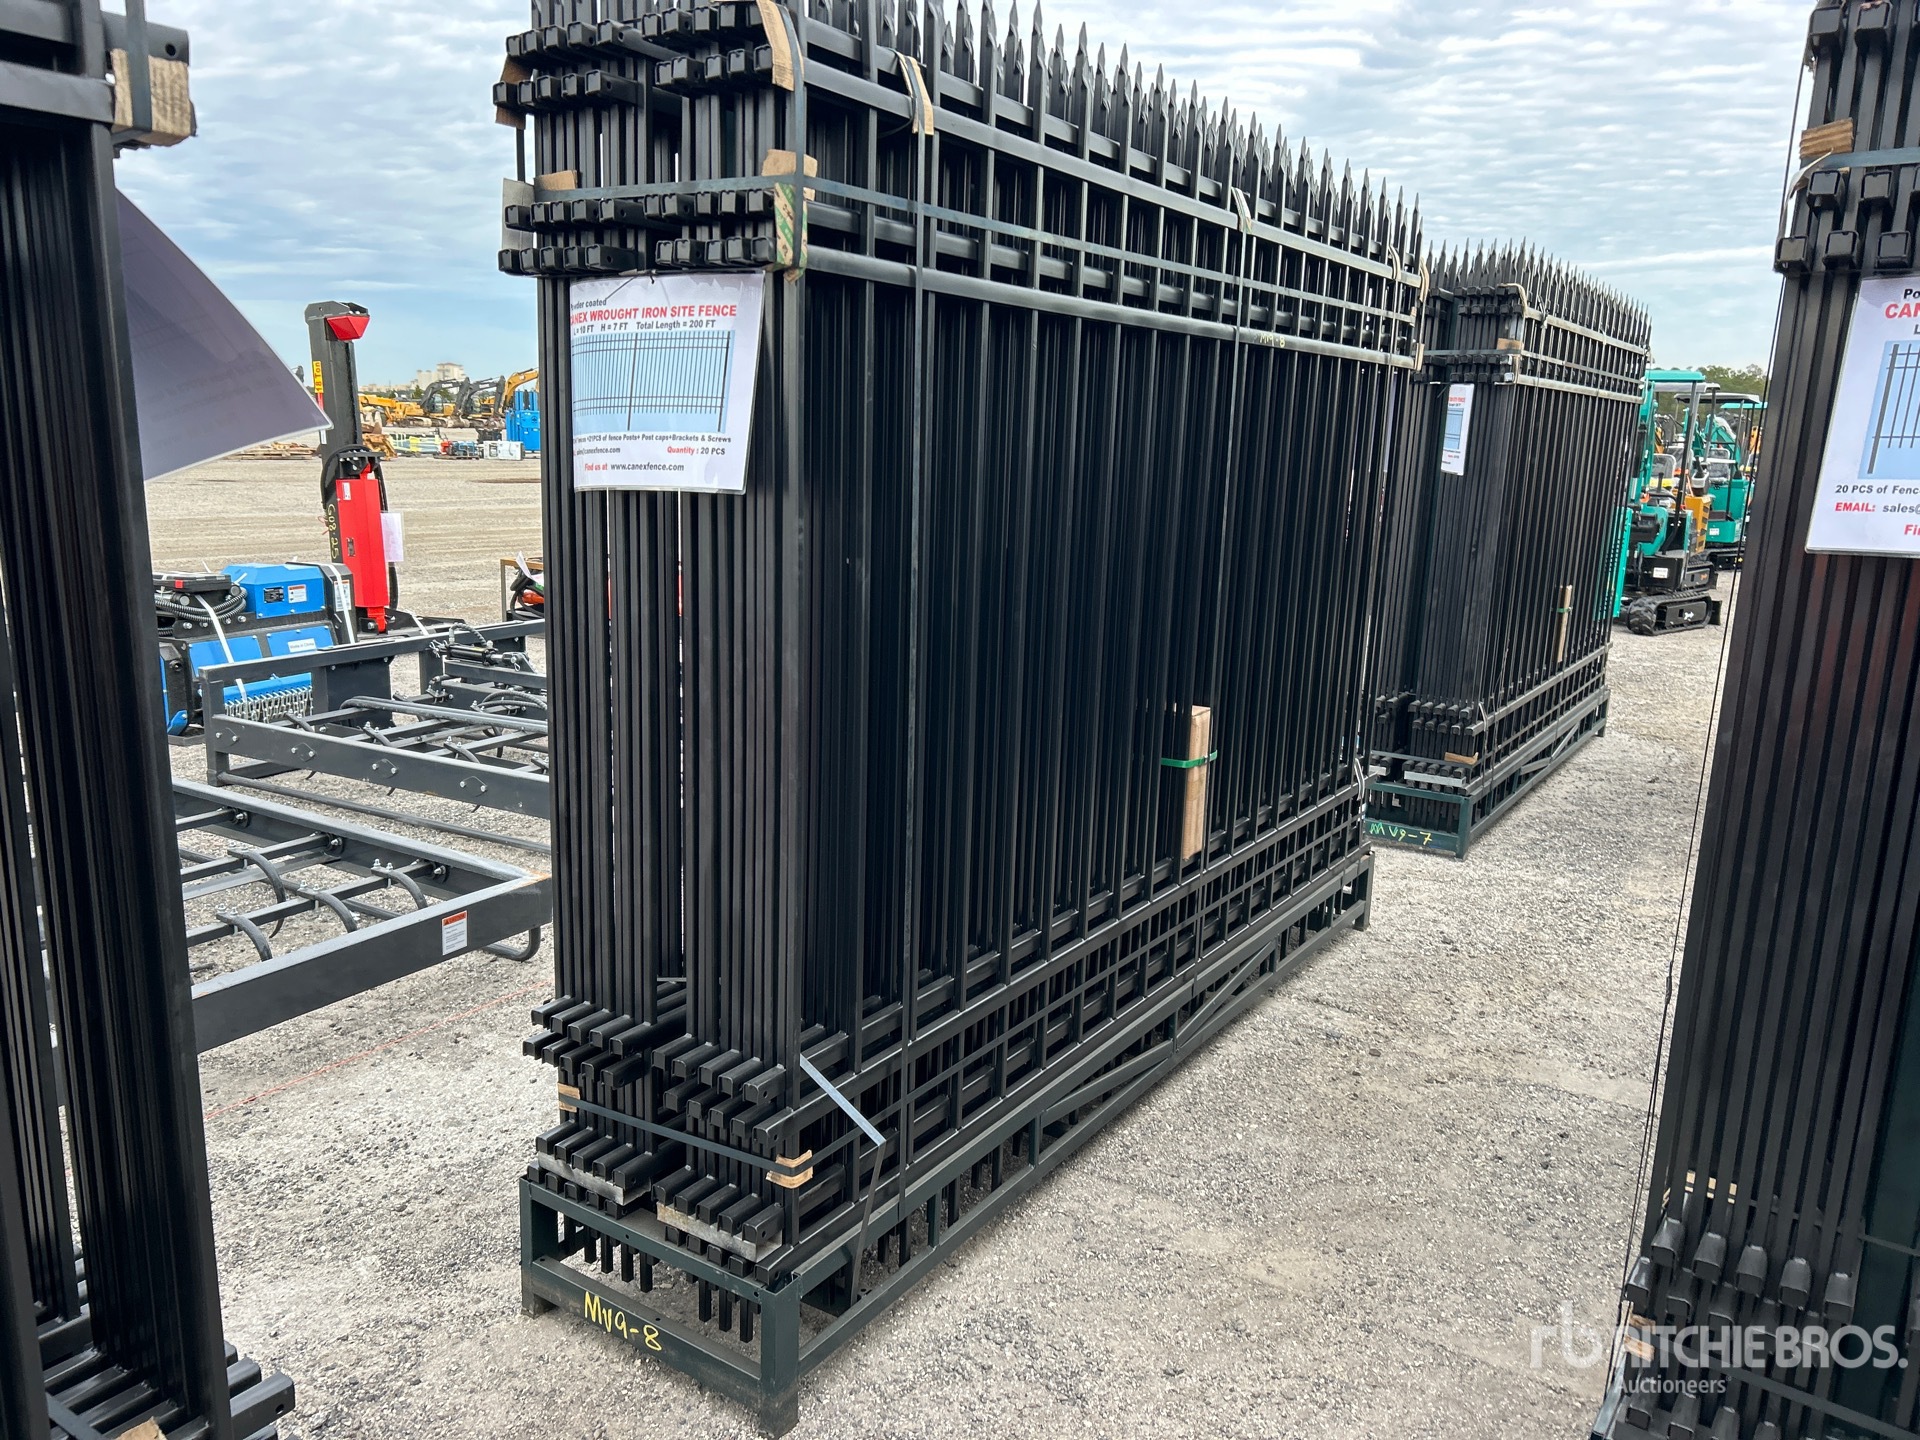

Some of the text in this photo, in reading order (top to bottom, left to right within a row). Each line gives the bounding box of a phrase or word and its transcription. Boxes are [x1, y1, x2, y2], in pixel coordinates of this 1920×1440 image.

[585, 299, 607, 308] coated
[590, 308, 639, 321] WROUGHT
[641, 306, 667, 319] IRON
[670, 305, 695, 317] SITE
[698, 304, 737, 317] FENCE
[586, 324, 594, 333] FT
[600, 323, 606, 331] H
[613, 322, 618, 330] 7
[619, 322, 628, 330] FT
[636, 320, 654, 330] Total
[656, 320, 681, 331] Length
[689, 319, 703, 328] 200
[705, 319, 716, 328] FT
[707, 435, 732, 443] Screws
[667, 446, 695, 455] Quantity
[610, 462, 684, 471] www.canexfence.com
[1835, 485, 1848, 493] 20
[1851, 485, 1873, 494] PCS
[1876, 485, 1888, 494] of
[1835, 502, 1876, 512] EMAIL:
